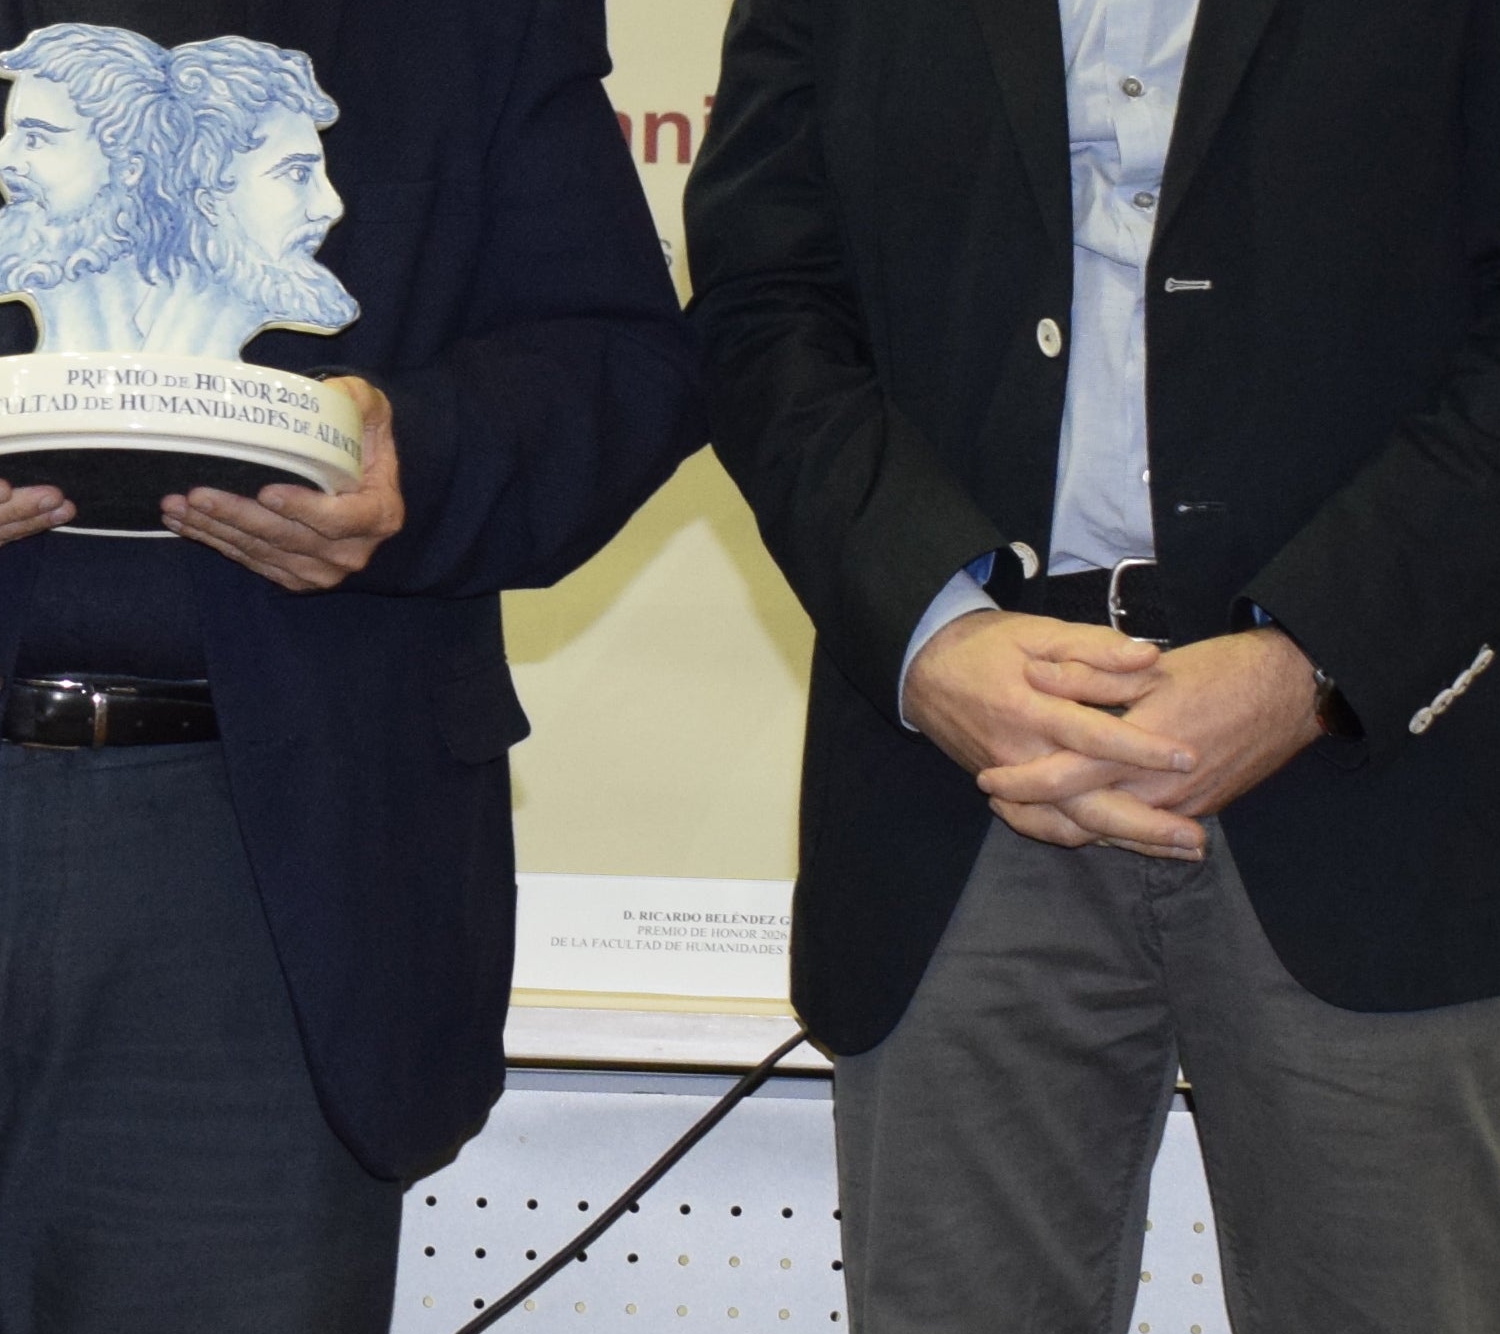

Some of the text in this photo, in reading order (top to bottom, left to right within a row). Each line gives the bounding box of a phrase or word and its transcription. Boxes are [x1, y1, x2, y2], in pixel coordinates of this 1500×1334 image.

[67, 369, 157, 388] PREMIO
[194, 373, 273, 404] HONOR
[276, 387, 320, 414] 2026
[119, 393, 289, 429] HUMANIDADES
[639, 911, 701, 923] RICARDO
[705, 912, 776, 925] BELÉNDEZ
[637, 925, 687, 937] PREMIO
[690, 927, 707, 937] DE
[711, 928, 757, 939] HONOR
[551, 936, 783, 954] DE LA FACULTAD DE HUMANIDADES
